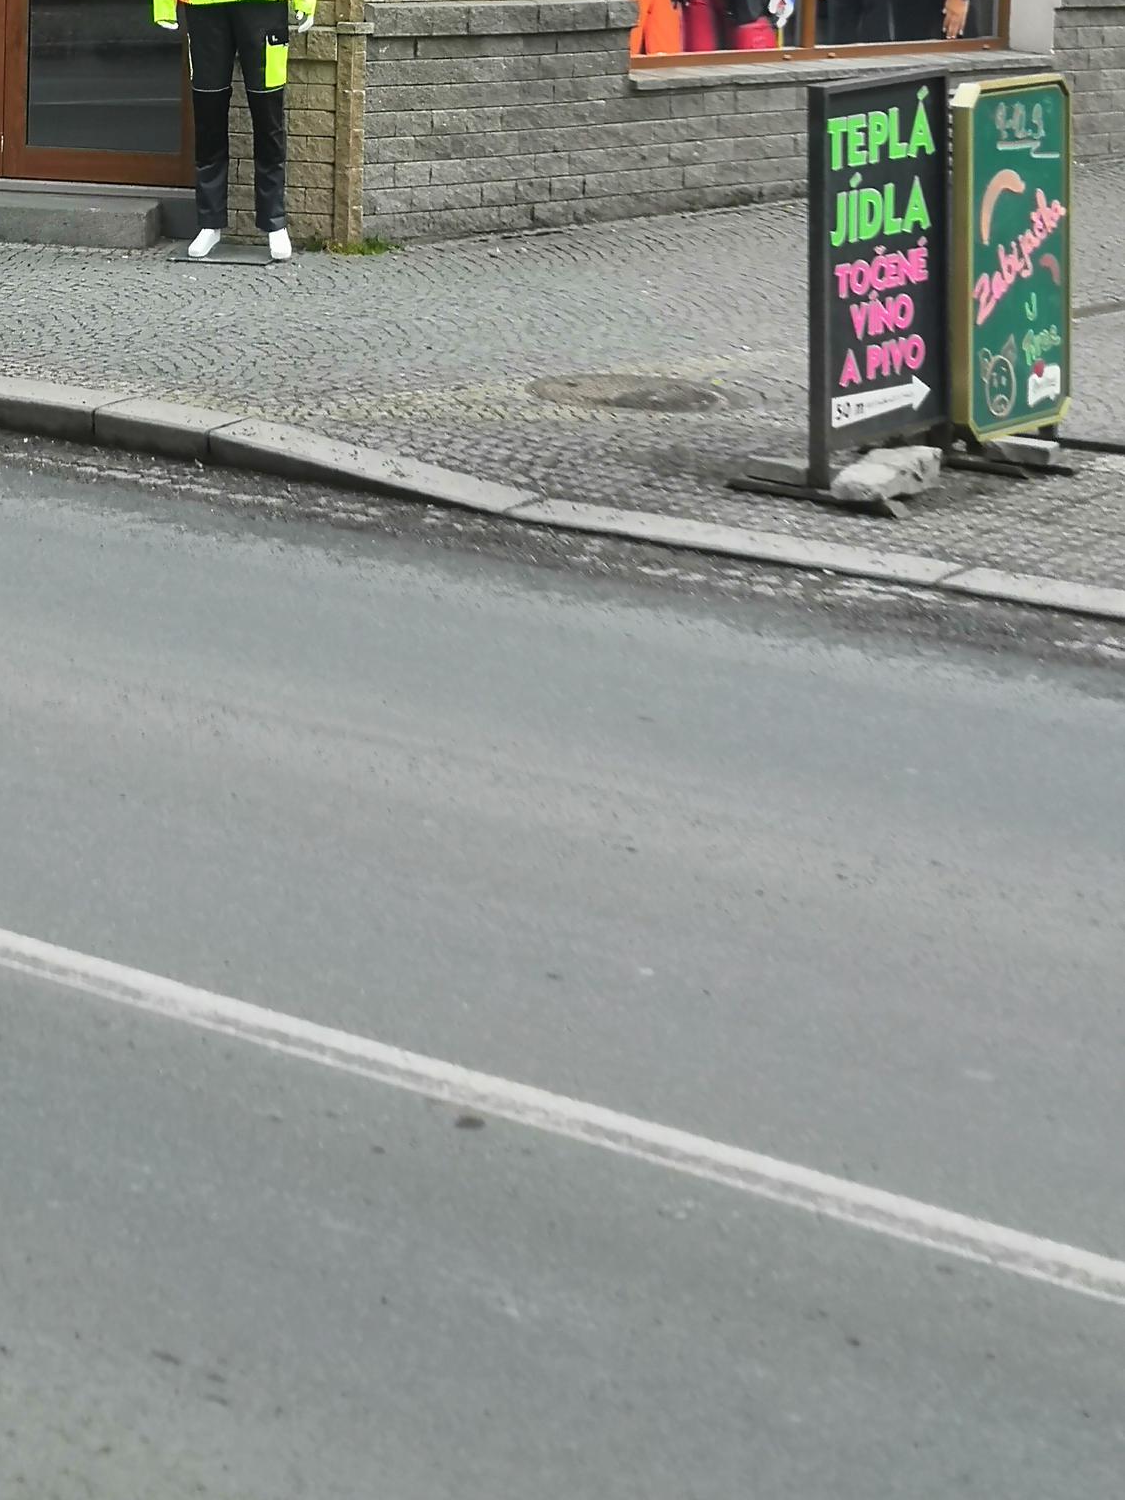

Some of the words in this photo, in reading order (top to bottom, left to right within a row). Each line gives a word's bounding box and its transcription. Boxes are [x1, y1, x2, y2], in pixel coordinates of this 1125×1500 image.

[827, 85, 936, 171] TEPLÁ
[830, 172, 932, 247] JÍDLA
[834, 236, 929, 299] TOČENÉ
[849, 290, 915, 341] VÍNO
[838, 348, 862, 388] A
[865, 333, 926, 380] PIVO
